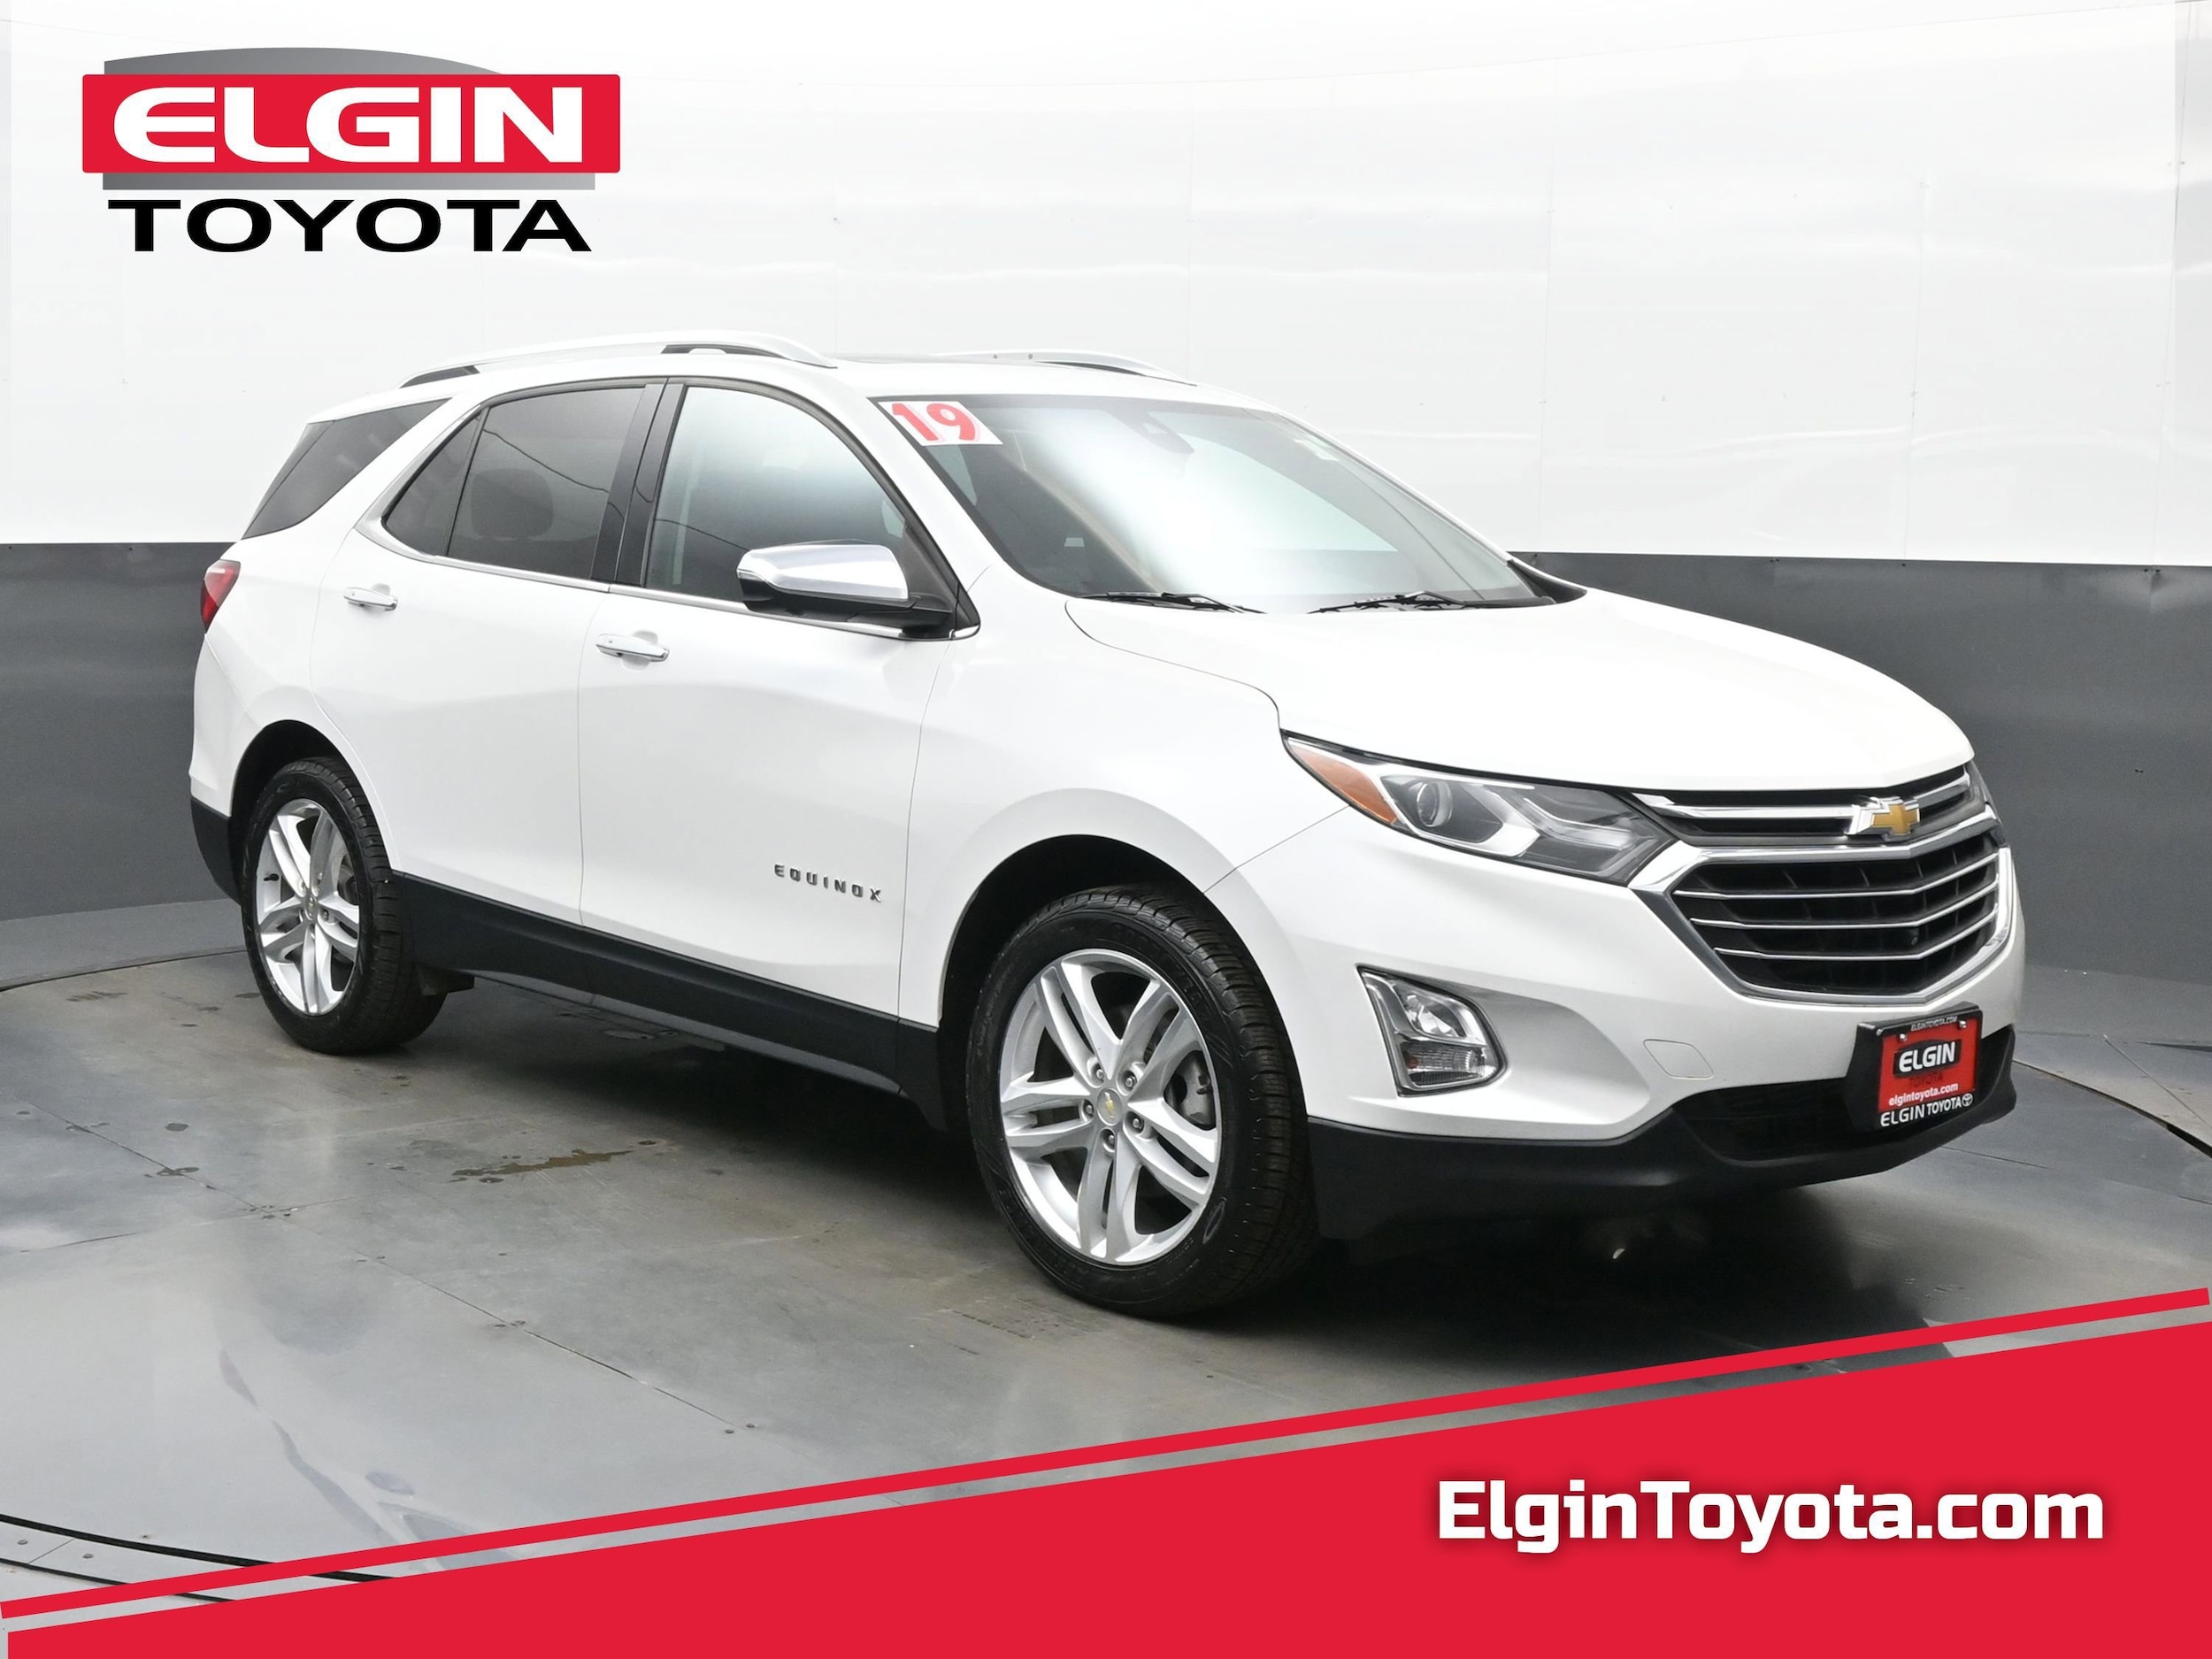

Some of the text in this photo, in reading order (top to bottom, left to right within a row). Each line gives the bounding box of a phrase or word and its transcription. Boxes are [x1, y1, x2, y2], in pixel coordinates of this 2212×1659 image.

[892, 403, 977, 441] 19
[774, 864, 881, 902] EQUINOX
[1898, 1041, 1956, 1073] ELGIN
[1888, 1082, 1959, 1107] elgintoyota.com
[1880, 1095, 1962, 1127] ELGIN TOYOTA
